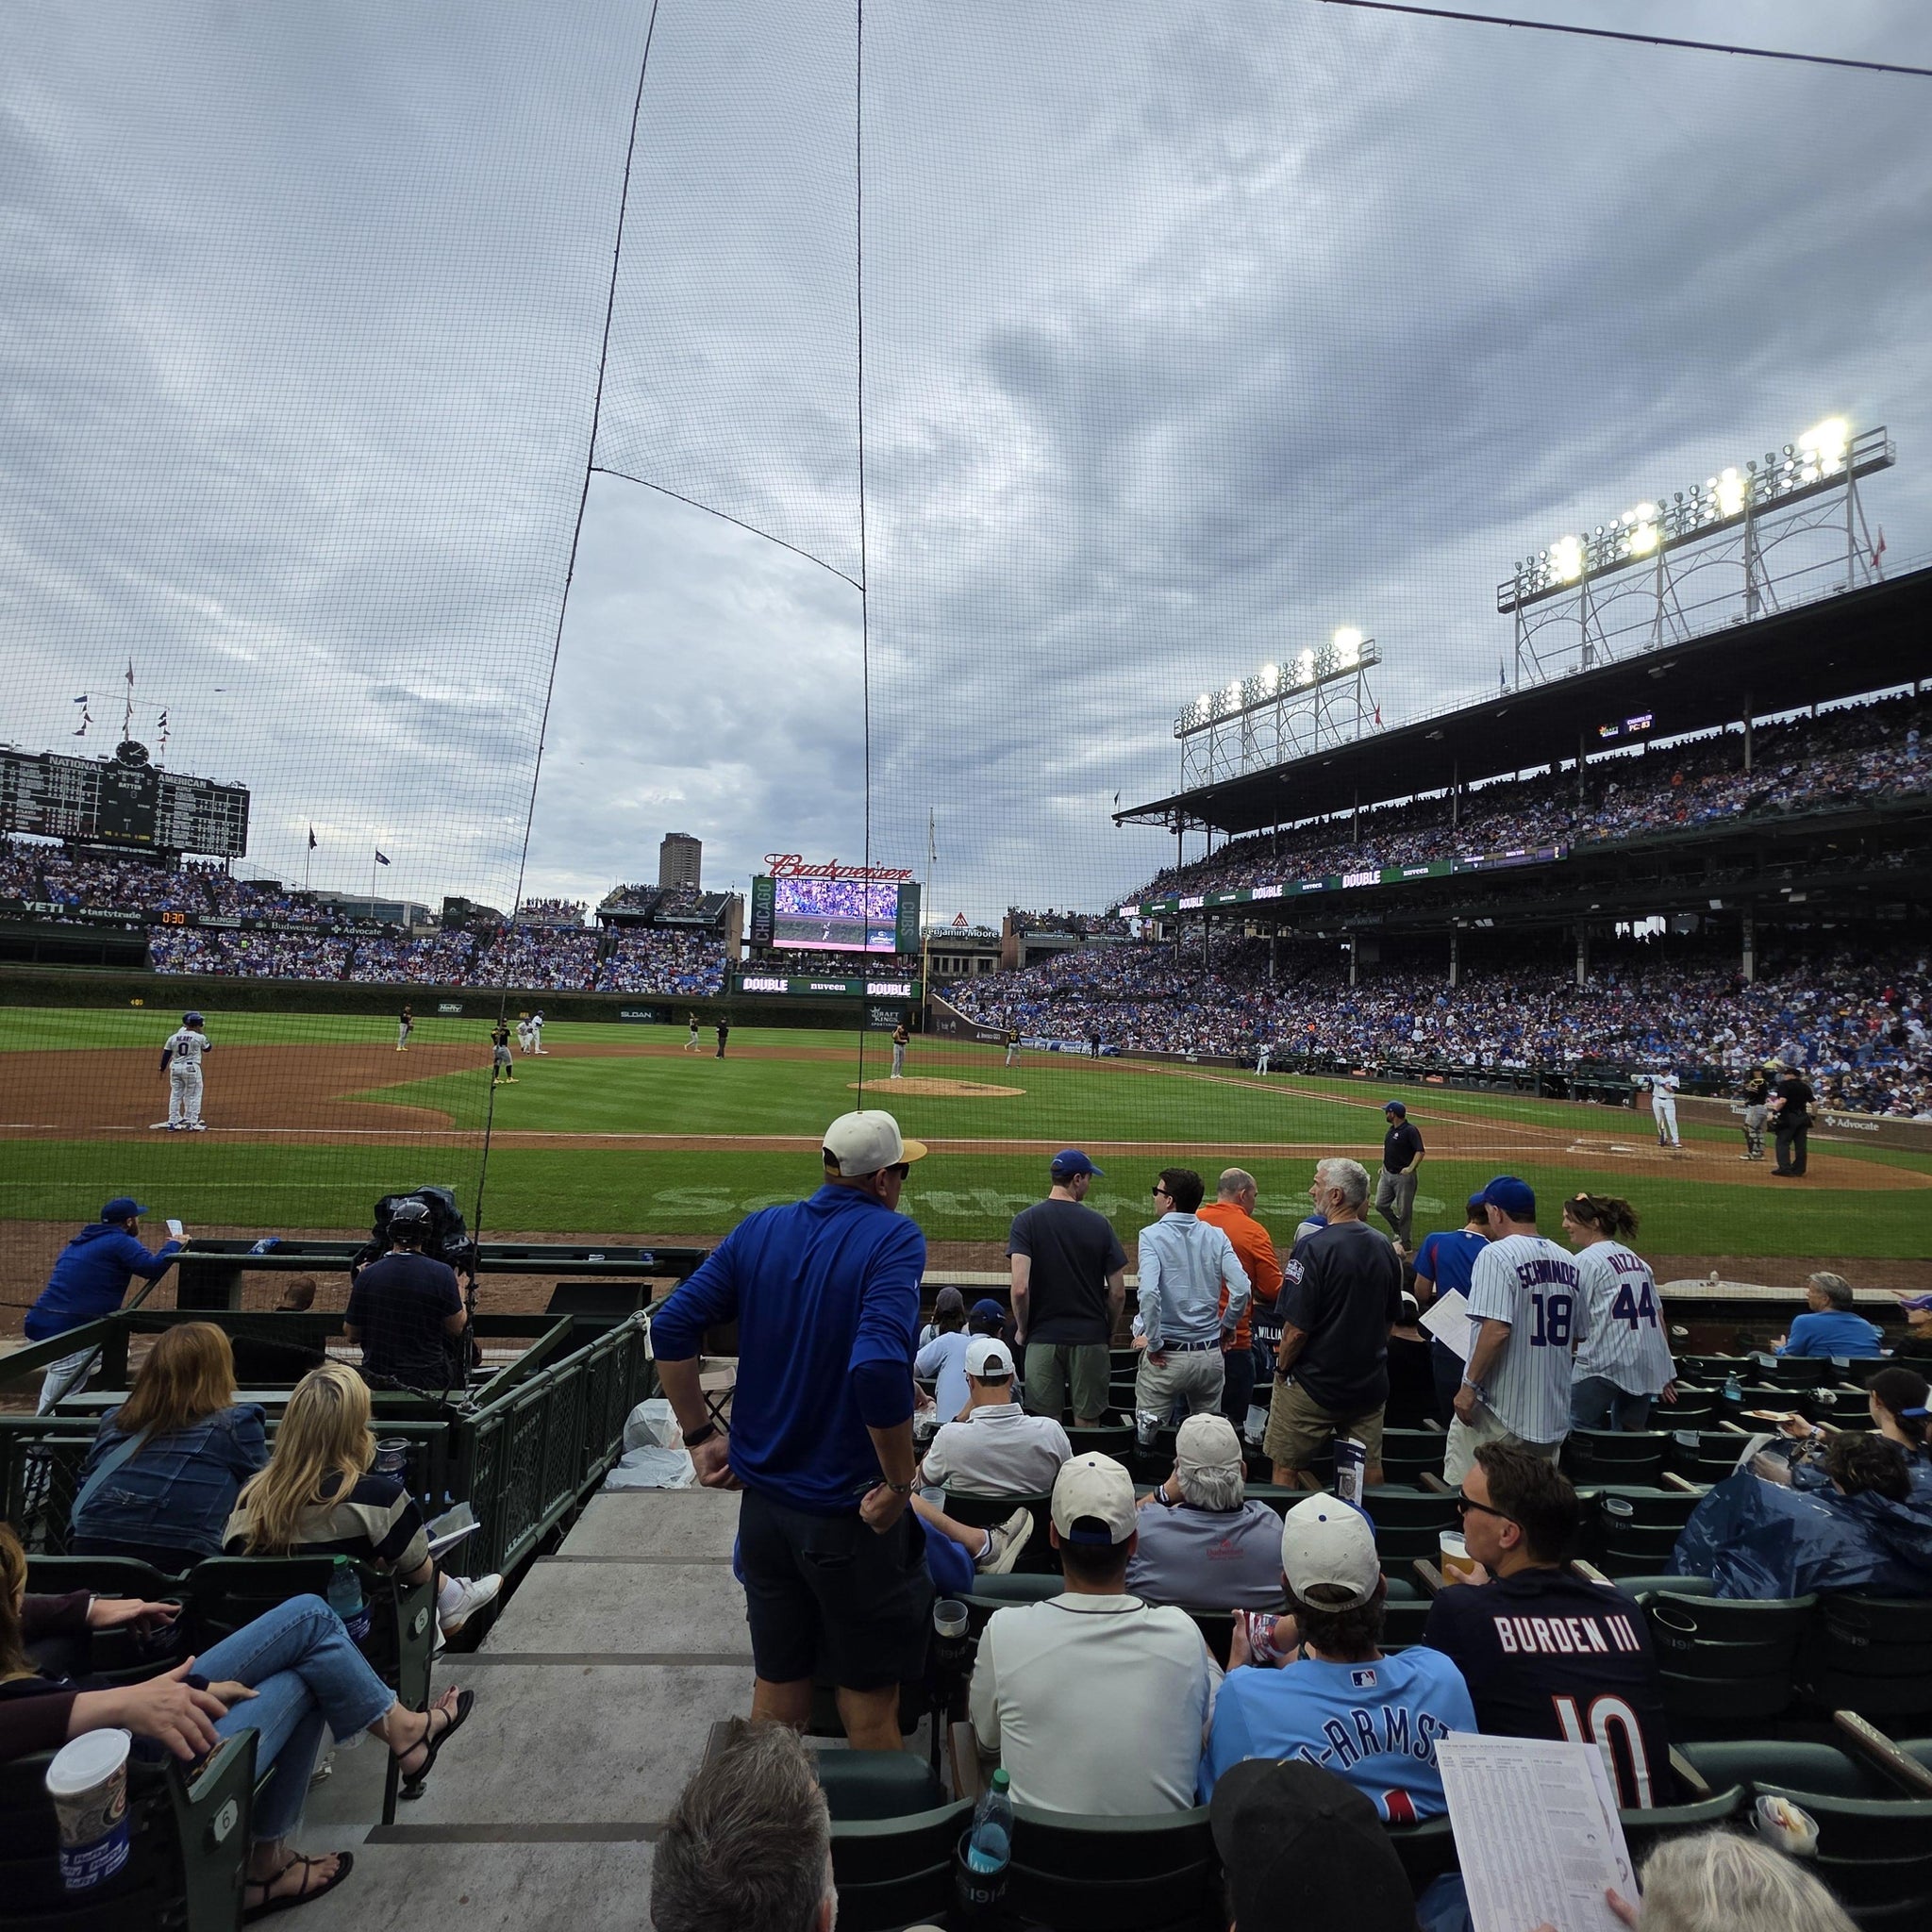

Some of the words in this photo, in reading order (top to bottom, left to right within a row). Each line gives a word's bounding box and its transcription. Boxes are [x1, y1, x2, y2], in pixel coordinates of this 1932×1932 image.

[49, 756, 104, 773] NATIONAL
[118, 782, 142, 791] BATTER
[158, 774, 207, 789] AMERICAN
[764, 853, 913, 881] Budweiser
[1342, 871, 1381, 889] DOUBLE
[1403, 867, 1429, 876] nuveen
[1252, 884, 1283, 900] DOUBLE
[23, 901, 64, 914] YETI
[1179, 896, 1205, 909] DOUBLE
[88, 908, 142, 920] tastytrade
[162, 912, 185, 924] 0:30
[755, 883, 773, 941] CHICAGO
[1119, 905, 1141, 918] DOUBLE
[198, 915, 242, 924] GRAINGER
[901, 901, 916, 937] CUBS
[271, 922, 319, 932] Budweiser
[343, 927, 382, 936] Advocate
[922, 926, 965, 941] Benjamin
[967, 928, 998, 939] Moore
[742, 977, 789, 991] DOUBLE
[866, 983, 911, 996] DOUBLE
[439, 1004, 462, 1012] Hefty
[872, 1009, 899, 1018] DRAFT
[178, 1042, 189, 1056] 0
[1837, 1118, 1880, 1131] Advocate
[1611, 1281, 1657, 1331] 44
[1530, 1293, 1574, 1347] 18
[419, 1614, 425, 1626] 5
[1492, 1615, 1609, 1653] BURDEN
[1605, 1614, 1641, 1652] III
[1552, 1693, 1654, 1809] 10
[222, 1811, 230, 1830] 6
